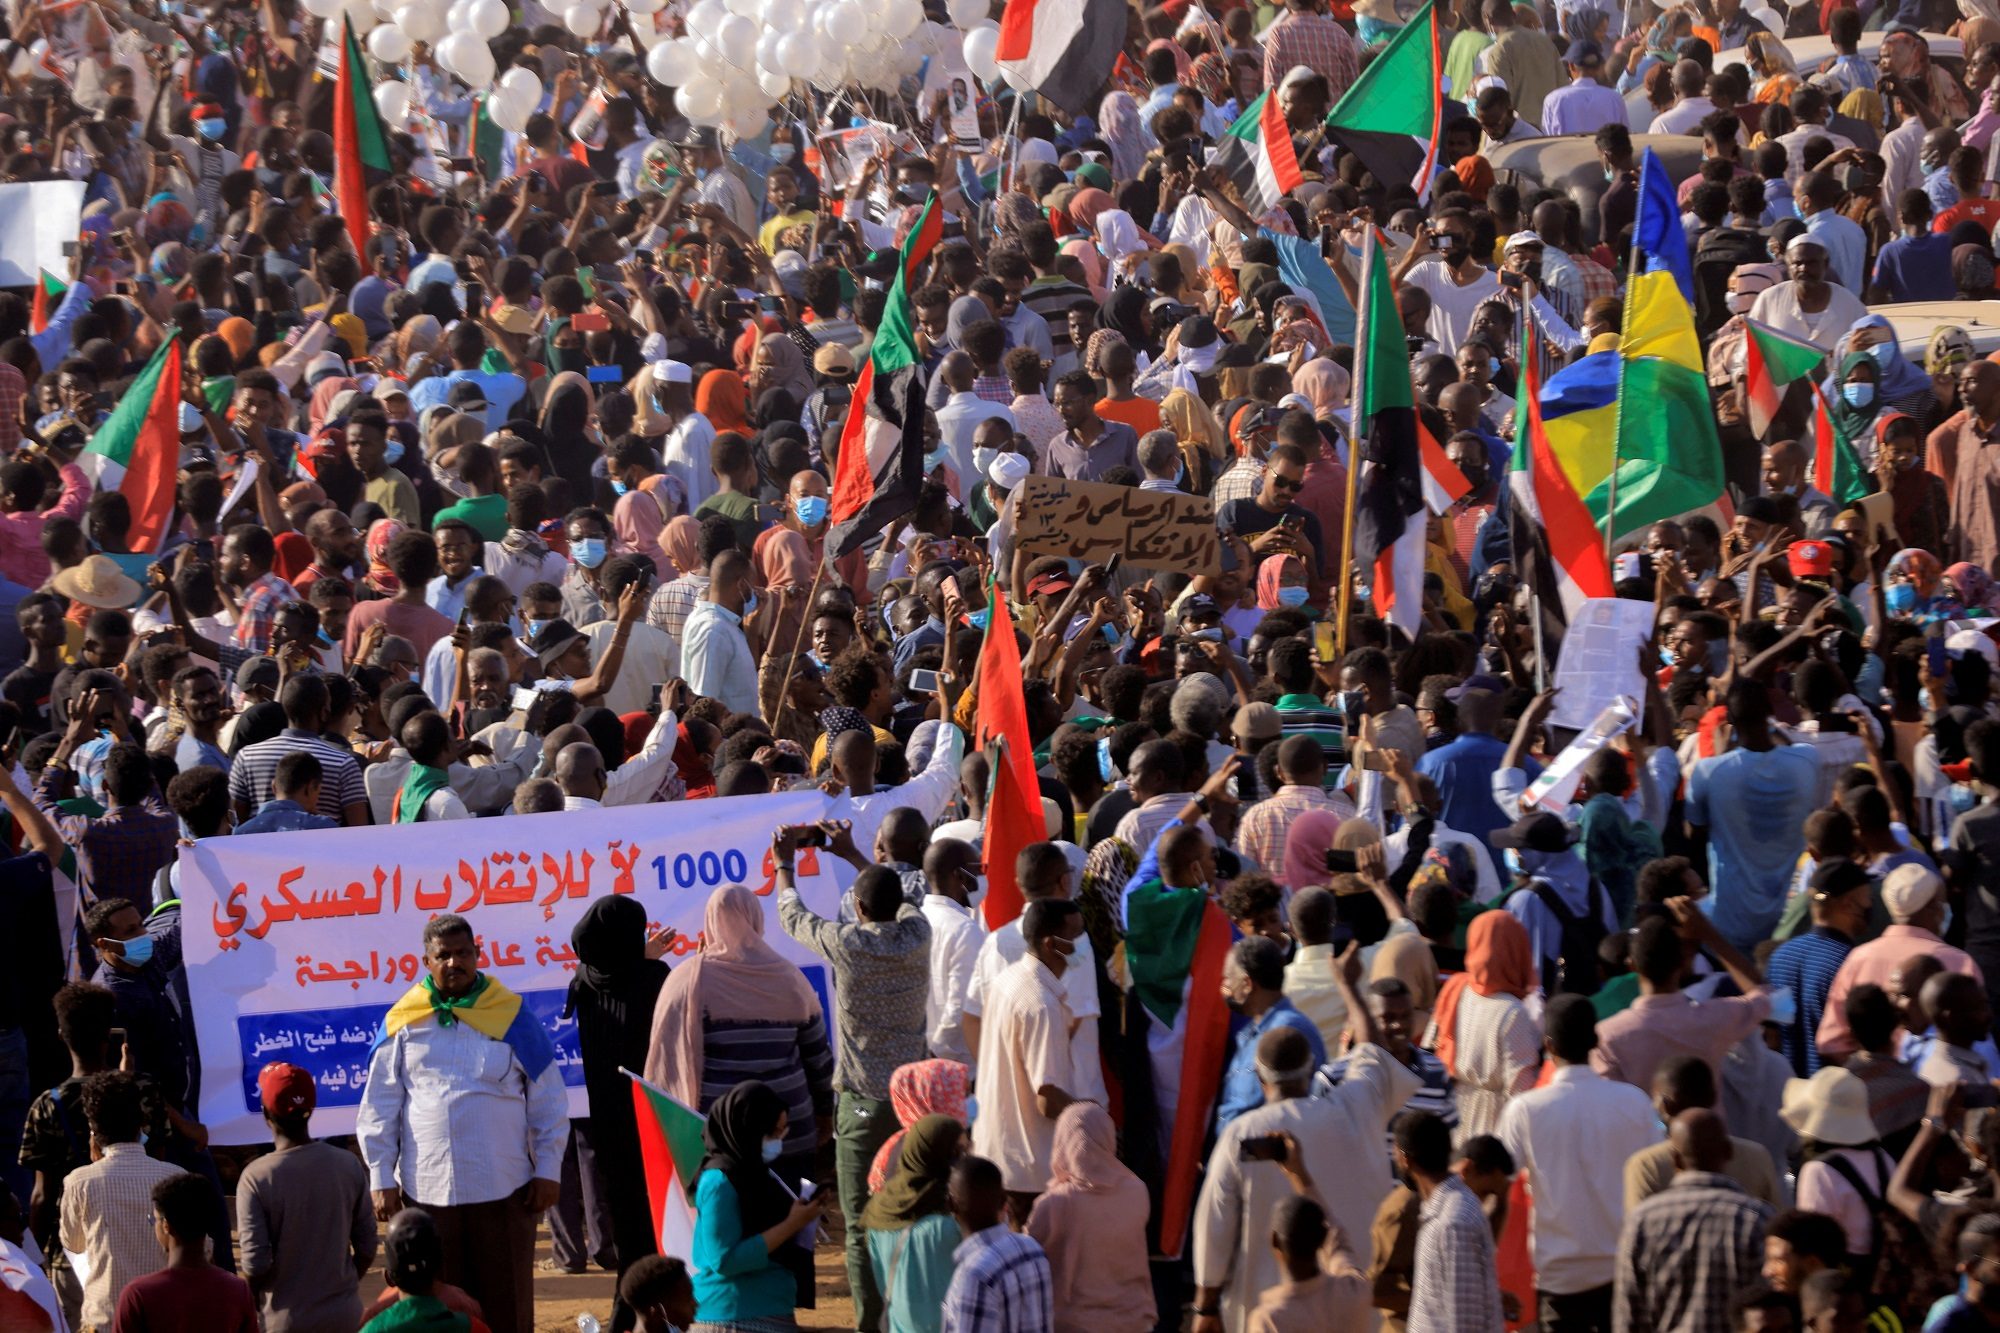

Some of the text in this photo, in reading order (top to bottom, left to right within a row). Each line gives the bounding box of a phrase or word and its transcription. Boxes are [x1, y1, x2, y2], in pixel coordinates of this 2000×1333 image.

[1086, 488, 1175, 528] الرصاص
[651, 848, 748, 892] 1000
[212, 863, 402, 952] العسكري
[251, 1029, 301, 1058] الخطر
[303, 1024, 337, 1053] شبح
